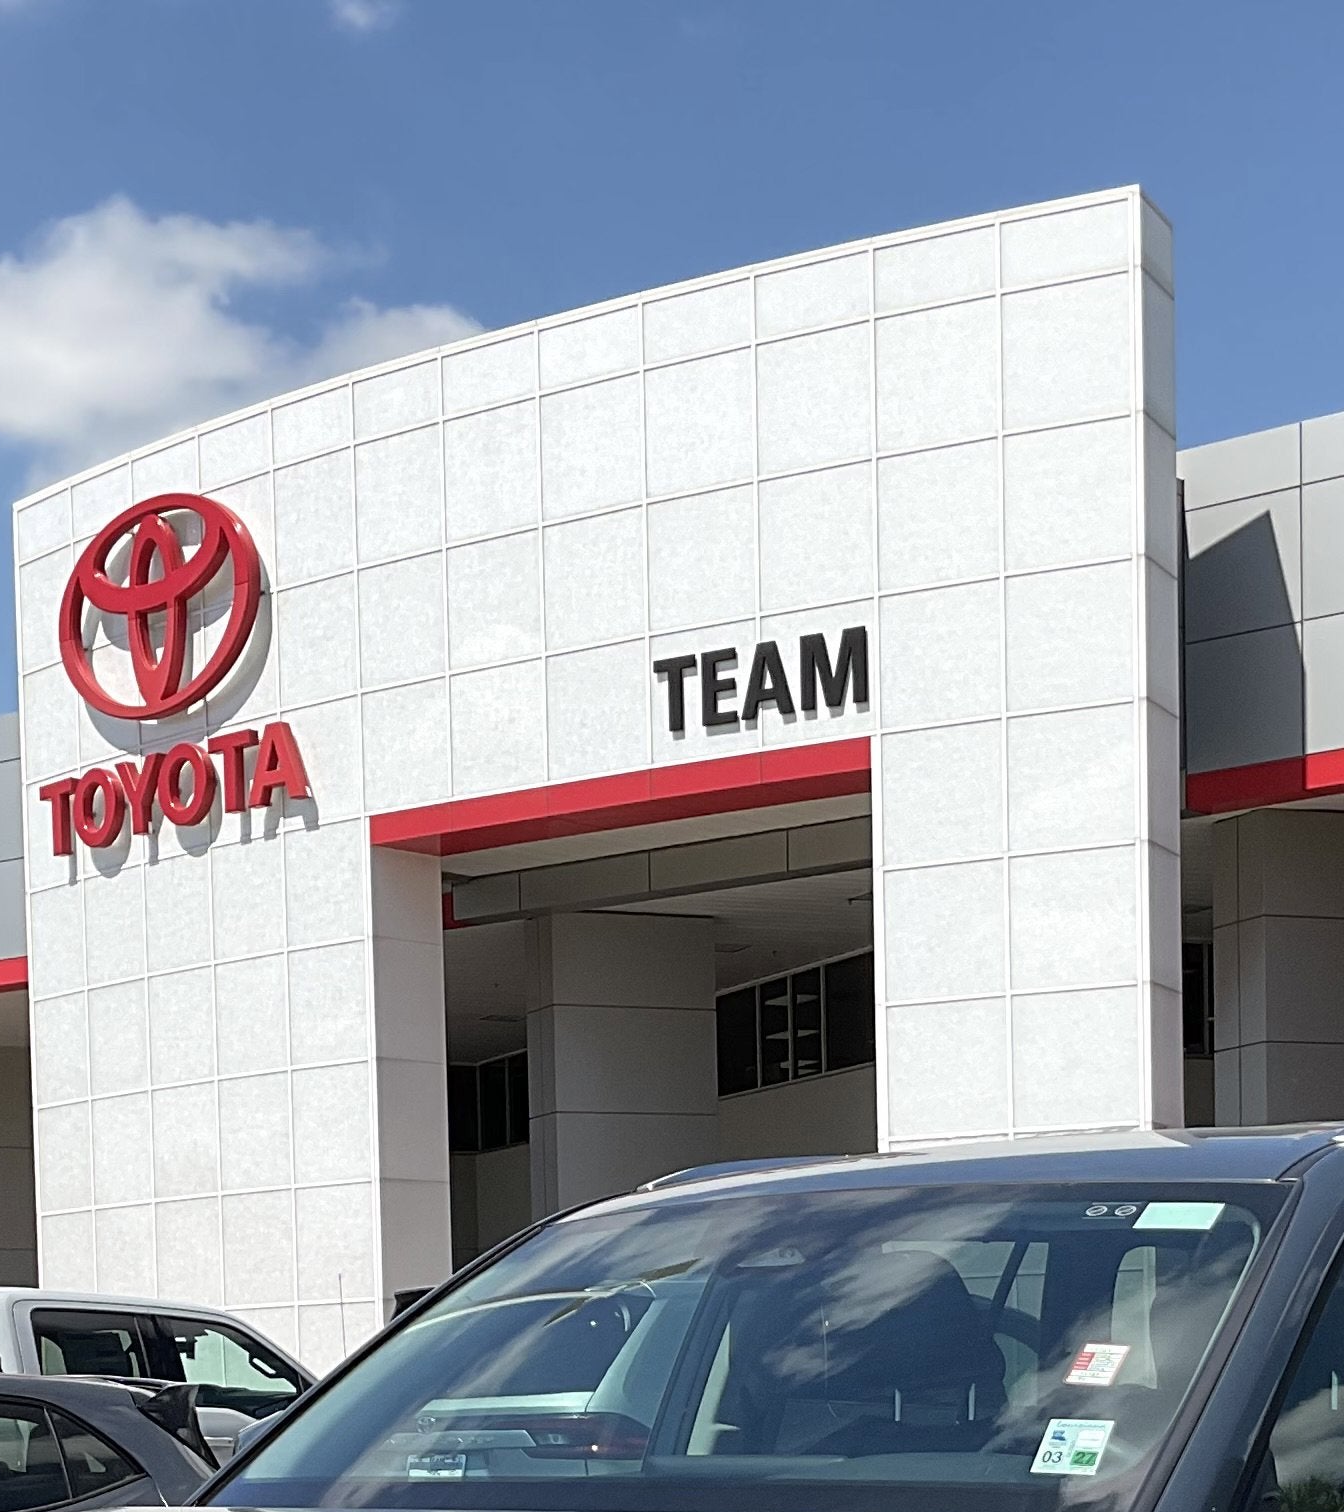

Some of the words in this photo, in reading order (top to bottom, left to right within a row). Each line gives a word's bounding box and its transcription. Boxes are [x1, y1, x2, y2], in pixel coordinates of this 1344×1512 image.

[653, 626, 869, 733] TEAM
[40, 721, 313, 857] TOYOTA
[1042, 1450, 1063, 1463] 03
[1073, 1451, 1097, 1464] 27
